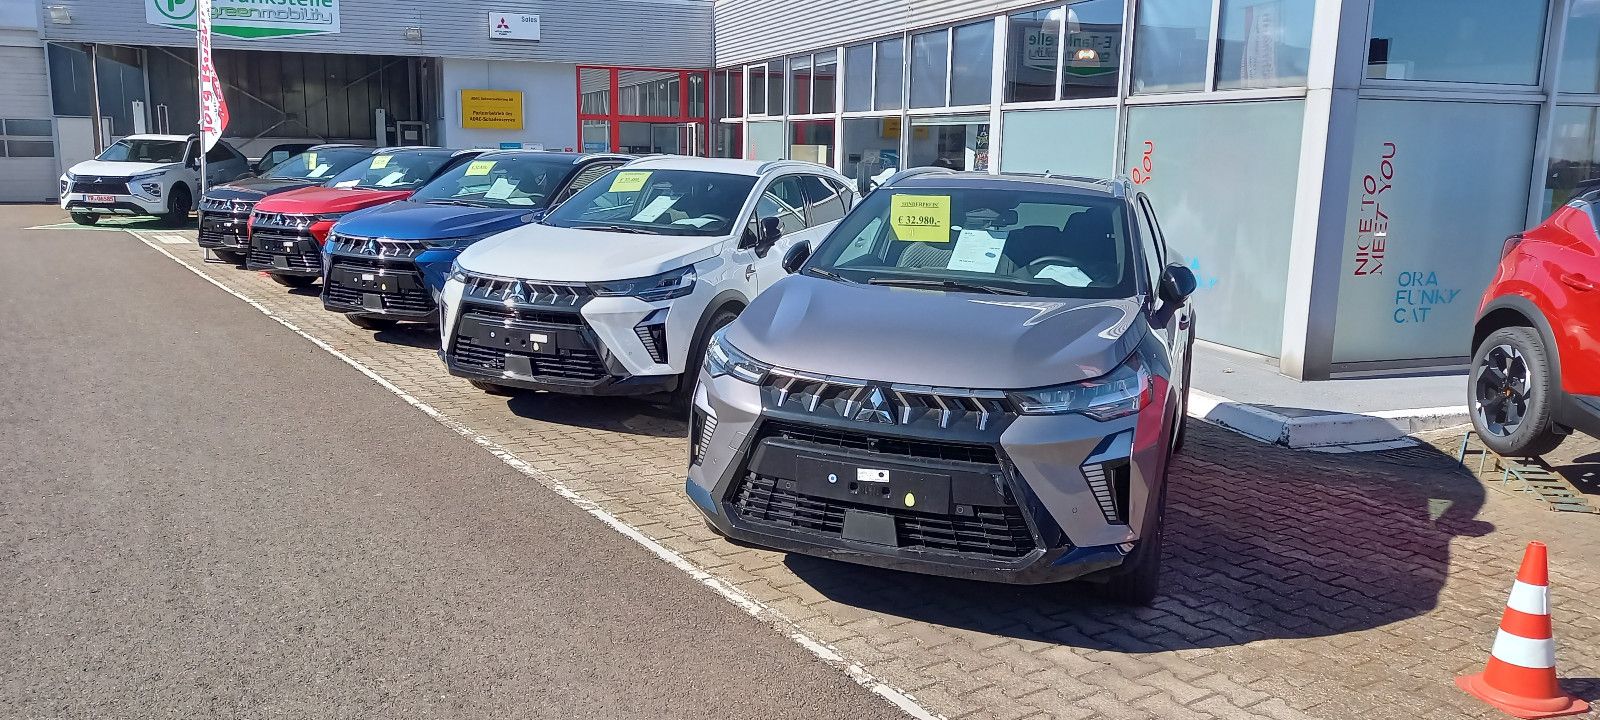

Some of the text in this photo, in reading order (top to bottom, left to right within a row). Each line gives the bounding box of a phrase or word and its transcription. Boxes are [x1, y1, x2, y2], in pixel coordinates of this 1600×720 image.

[1142, 141, 1153, 184] YOU
[1369, 142, 1396, 276] MEET YOU
[898, 215, 904, 224] €
[1354, 175, 1377, 276] NICE TO
[1397, 271, 1438, 287] ORA
[1395, 288, 1461, 305] FUNKY
[1393, 307, 1431, 324] CAT
